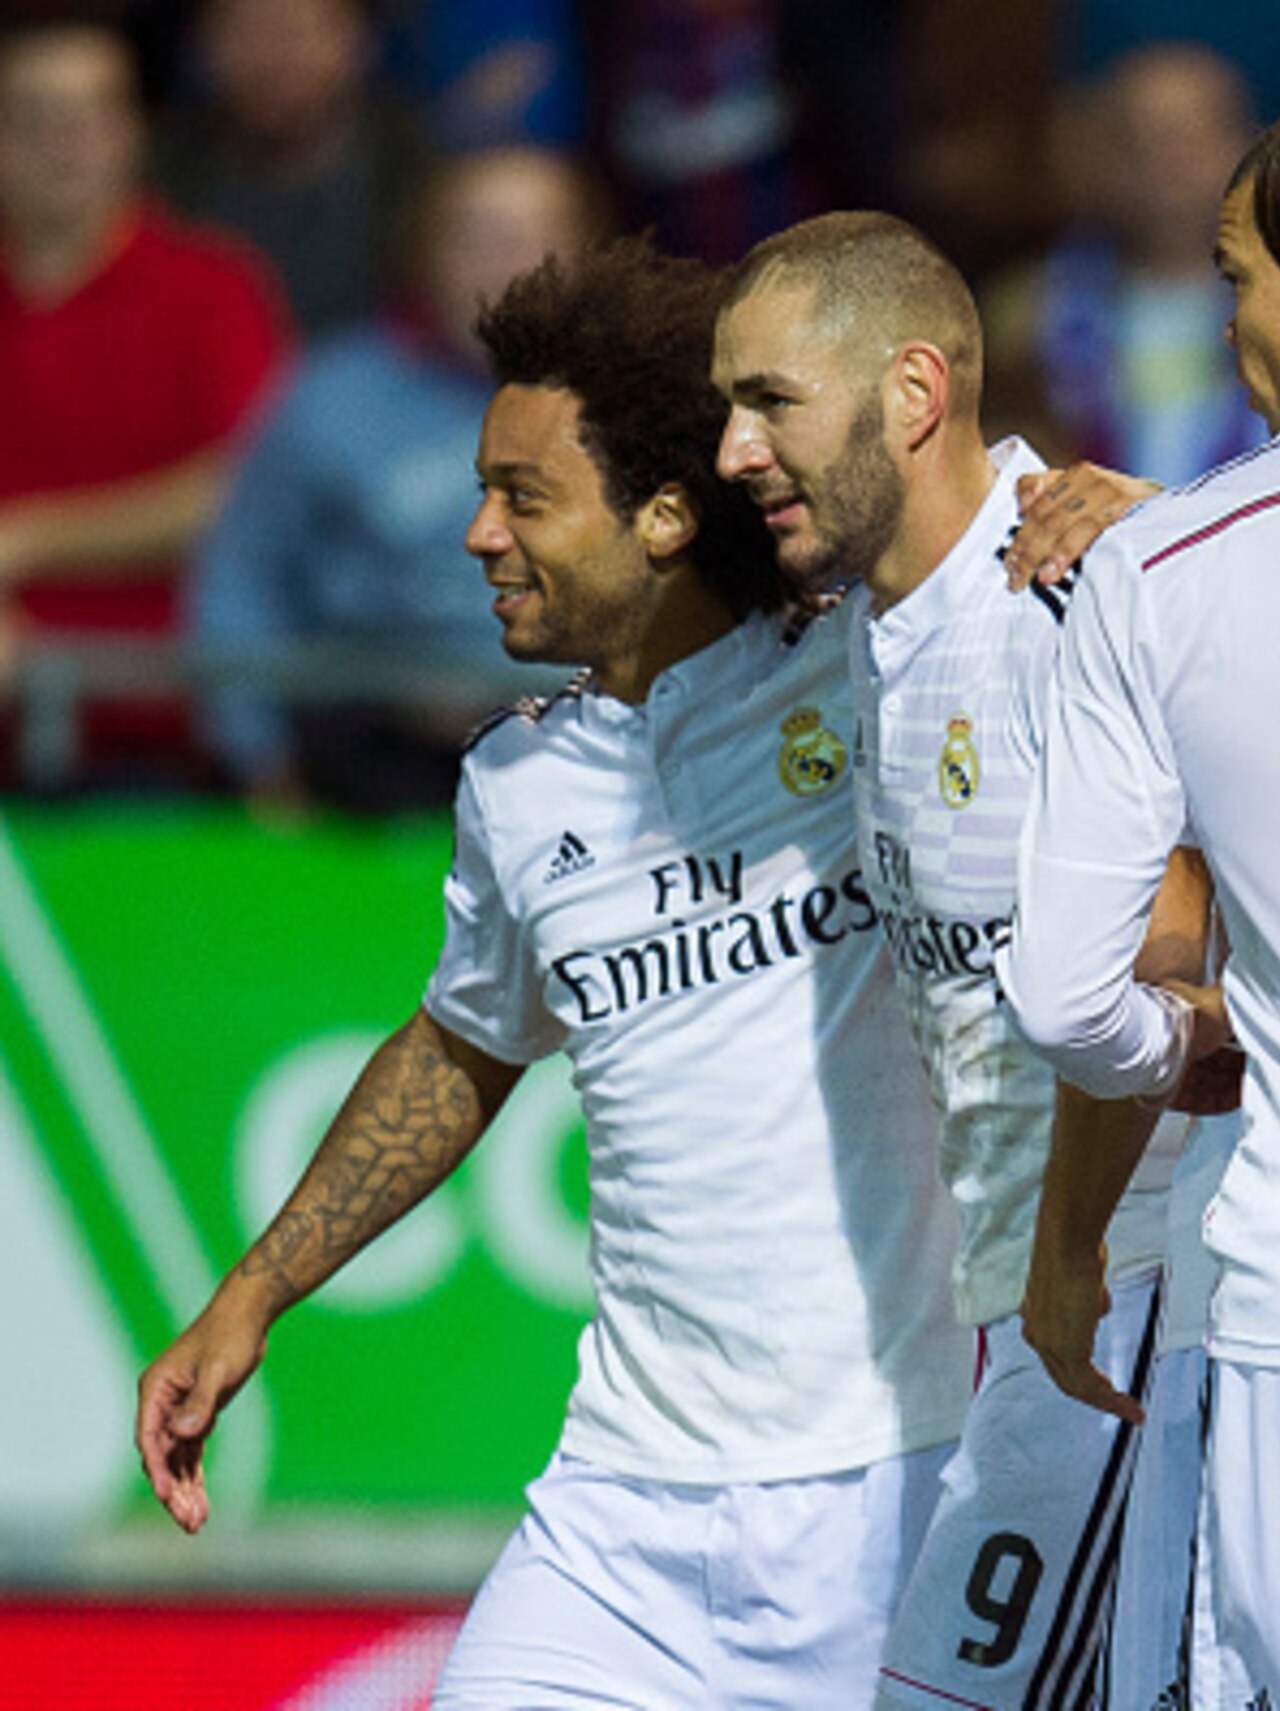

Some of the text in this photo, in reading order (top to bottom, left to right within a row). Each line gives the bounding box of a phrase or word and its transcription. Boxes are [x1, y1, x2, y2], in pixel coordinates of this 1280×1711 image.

[551, 869, 878, 1023] Emirates
[650, 851, 742, 914] Fly
[955, 1530, 1044, 1669] 9
